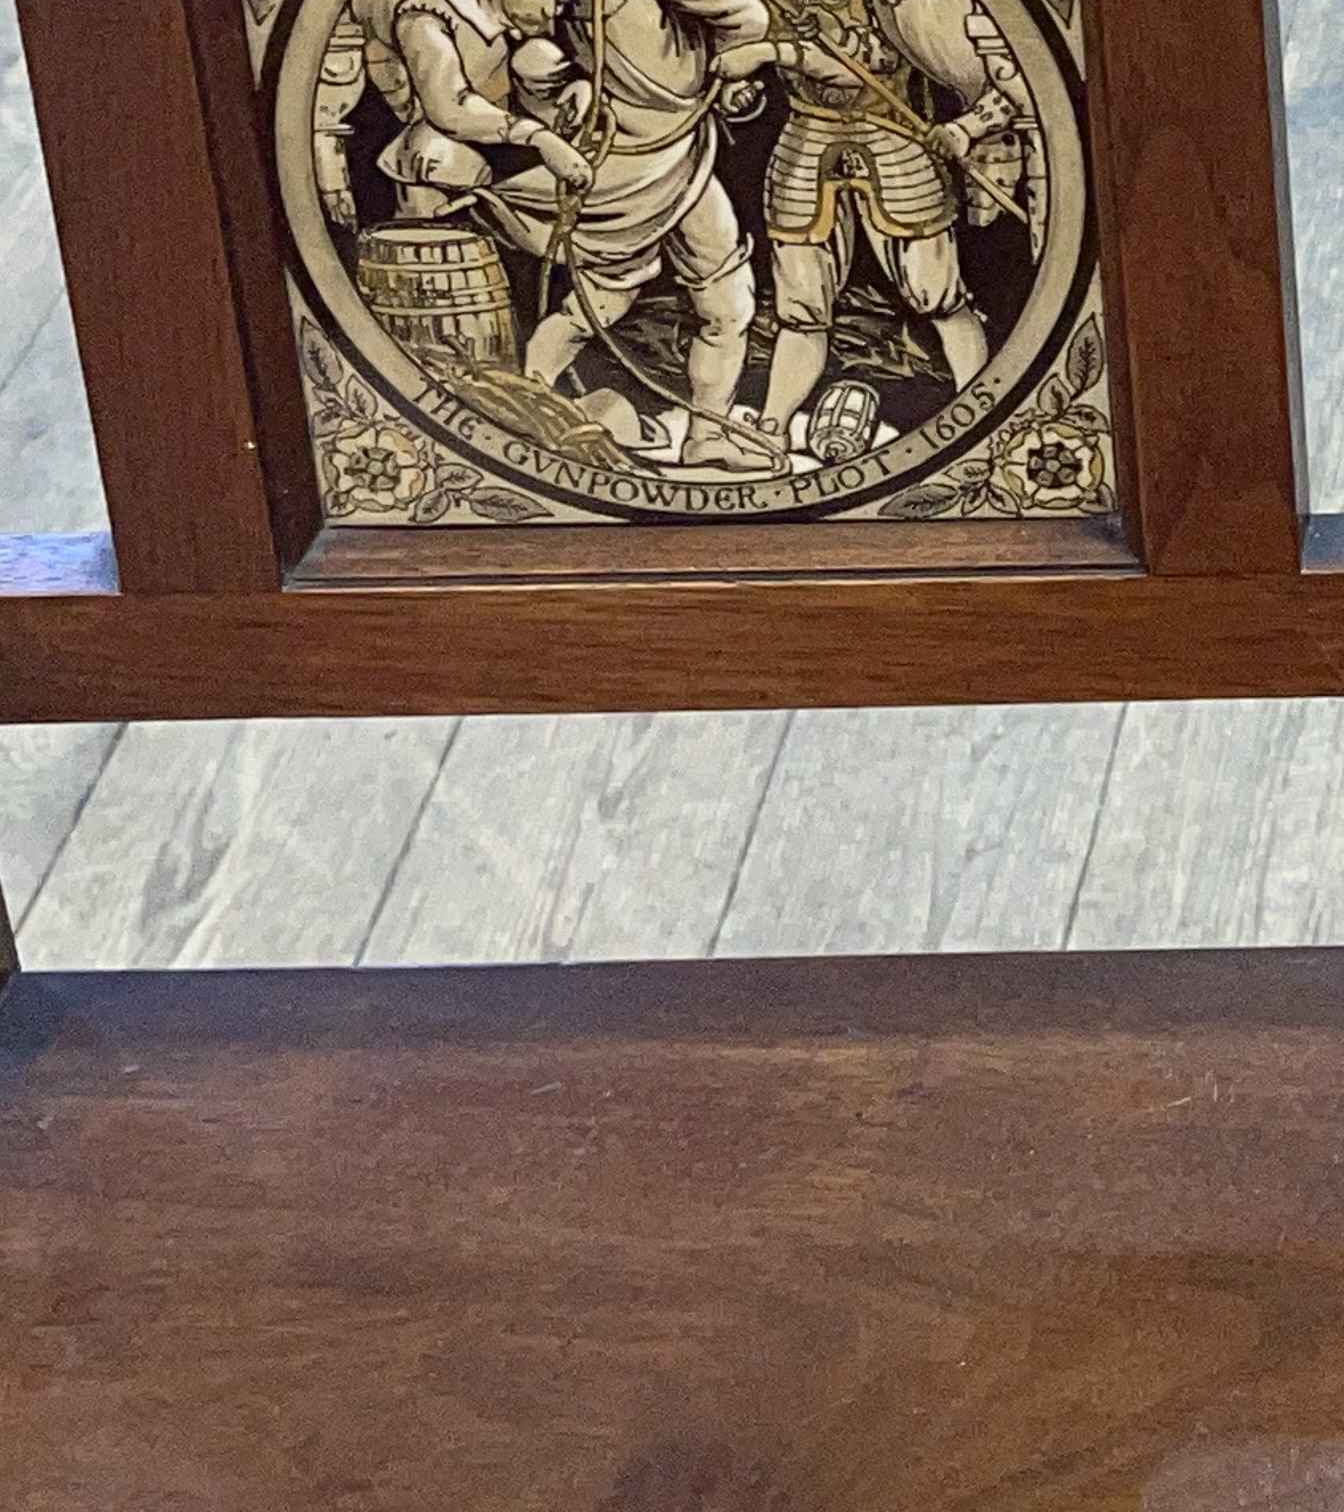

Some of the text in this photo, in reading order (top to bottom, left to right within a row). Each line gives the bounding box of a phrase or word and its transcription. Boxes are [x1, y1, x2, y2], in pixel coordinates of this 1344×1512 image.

[413, 377, 482, 439] THE
[789, 450, 890, 504] PLOT
[920, 382, 996, 449] 1605
